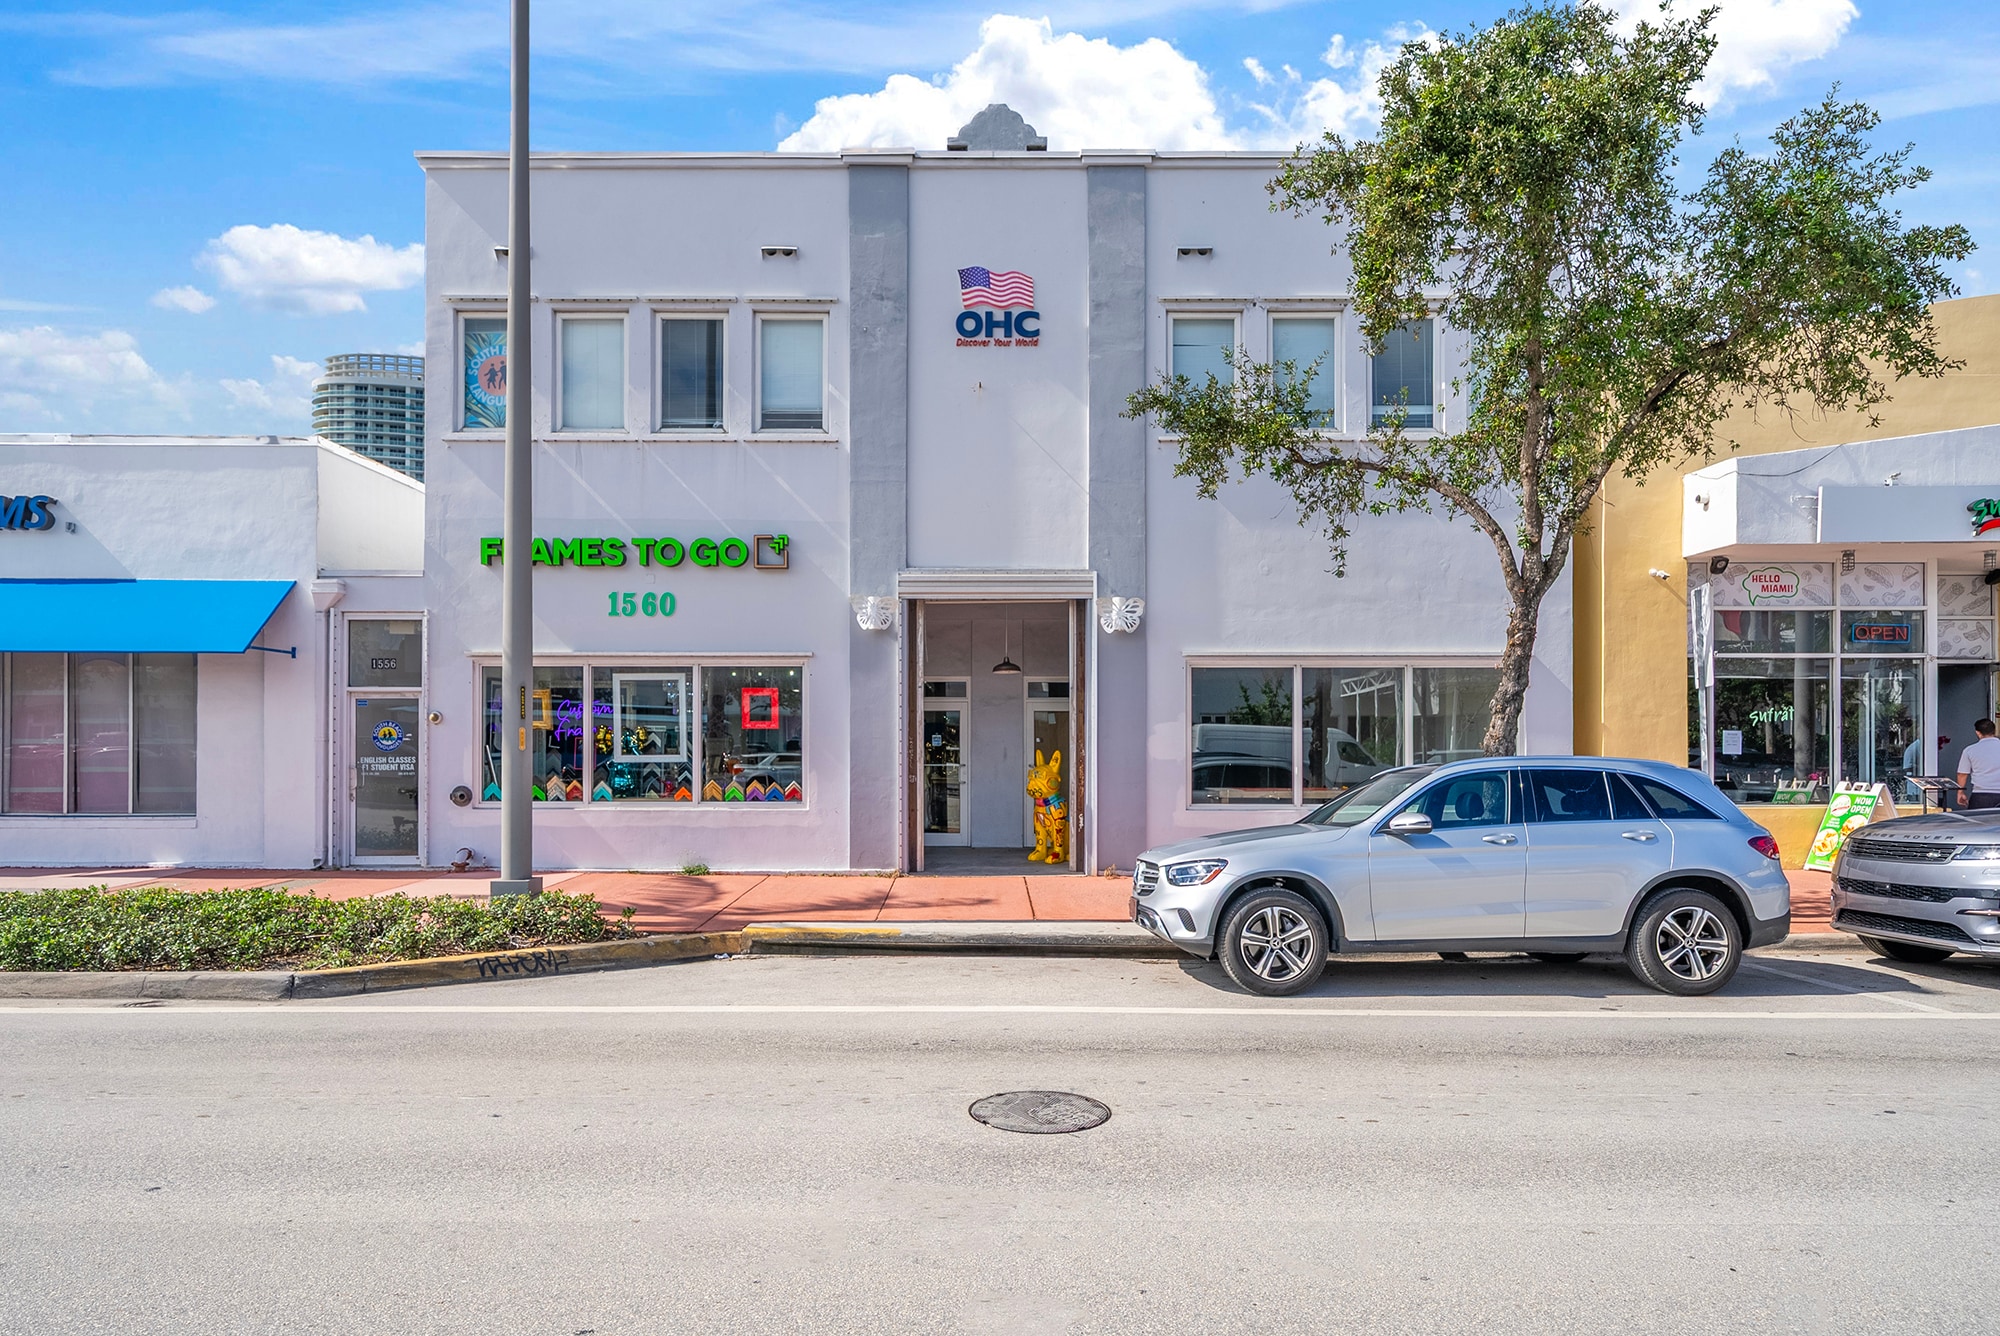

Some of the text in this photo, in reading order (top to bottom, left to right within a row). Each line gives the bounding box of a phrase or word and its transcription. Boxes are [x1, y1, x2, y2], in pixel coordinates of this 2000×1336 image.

[956, 311, 1040, 338] OHC
[956, 338, 1039, 347] Discover Your World
[467, 345, 500, 376] SOUTH
[480, 537, 748, 567] FAMES TO GO
[1752, 574, 1780, 583] HELLO
[1761, 584, 1794, 592] MIAMI!
[608, 592, 676, 617] 1560
[1855, 626, 1908, 640] OPEN
[372, 659, 396, 668] 1556
[1854, 796, 1875, 805] NOW
[1850, 805, 1871, 814] OPEN
